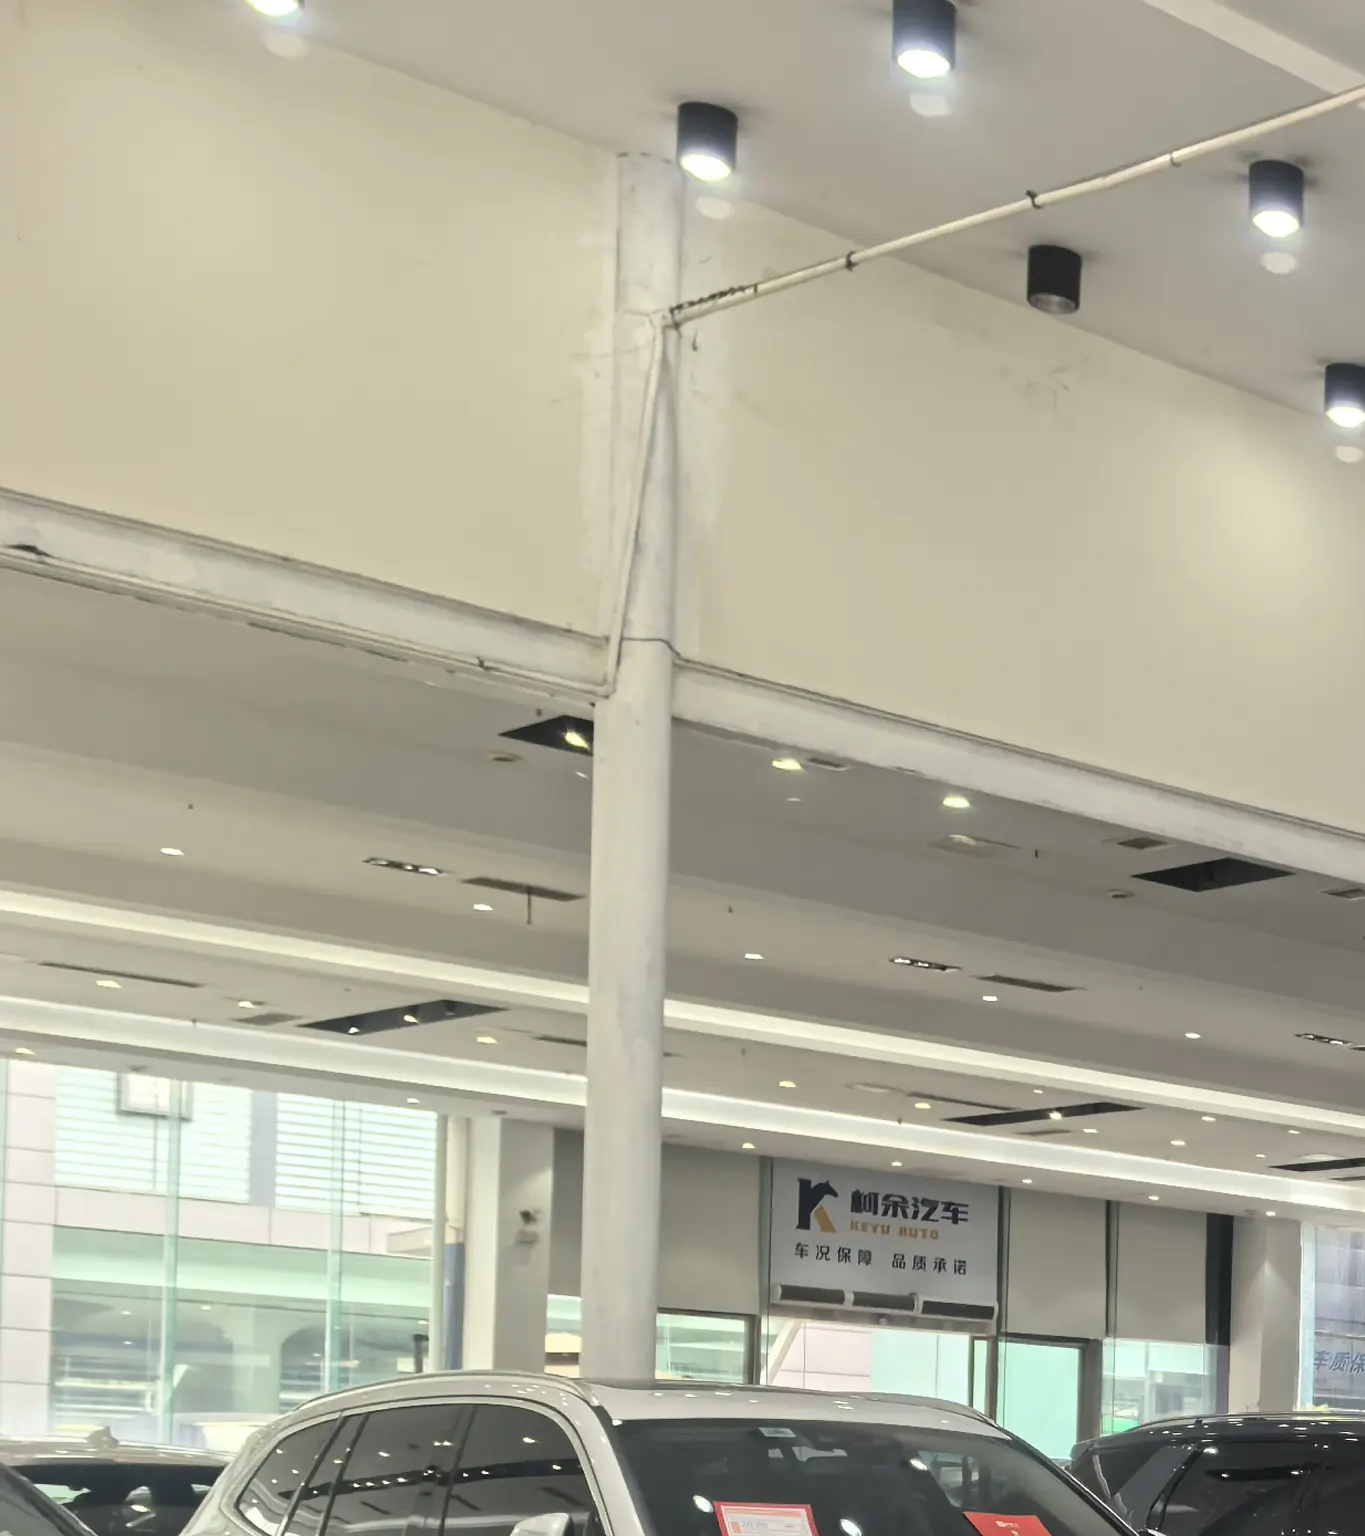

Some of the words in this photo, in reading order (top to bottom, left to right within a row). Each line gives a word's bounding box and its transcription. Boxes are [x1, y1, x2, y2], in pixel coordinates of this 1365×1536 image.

[850, 1219, 891, 1235] KEYU
[899, 1226, 940, 1240] AUTO
[794, 1242, 873, 1266] 车况保障
[892, 1252, 967, 1276] 品质承诺
